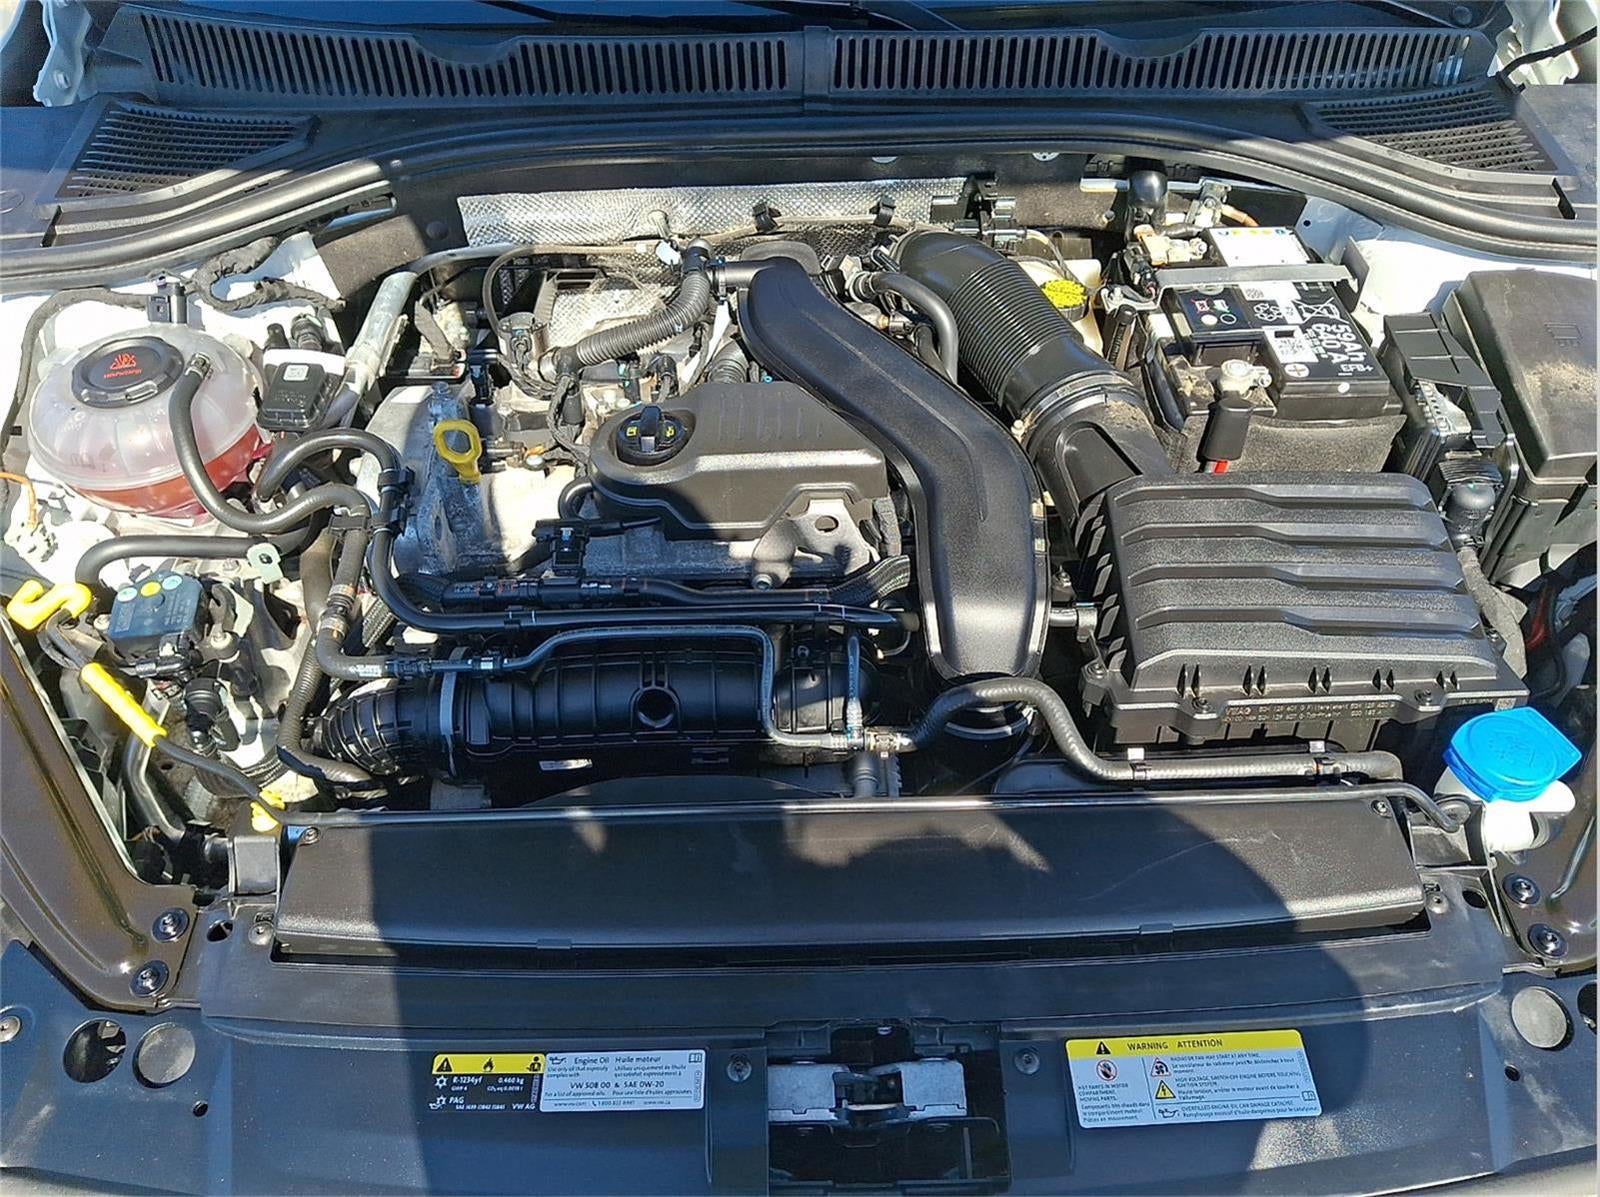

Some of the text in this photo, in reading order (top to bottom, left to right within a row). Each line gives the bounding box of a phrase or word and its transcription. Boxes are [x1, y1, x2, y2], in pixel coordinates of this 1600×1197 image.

[1327, 351, 1349, 364] A
[1127, 1038, 1222, 1050] WARNING ATTENTION
[574, 1057, 598, 1065] Engine
[453, 1076, 482, 1085] R-1234yf
